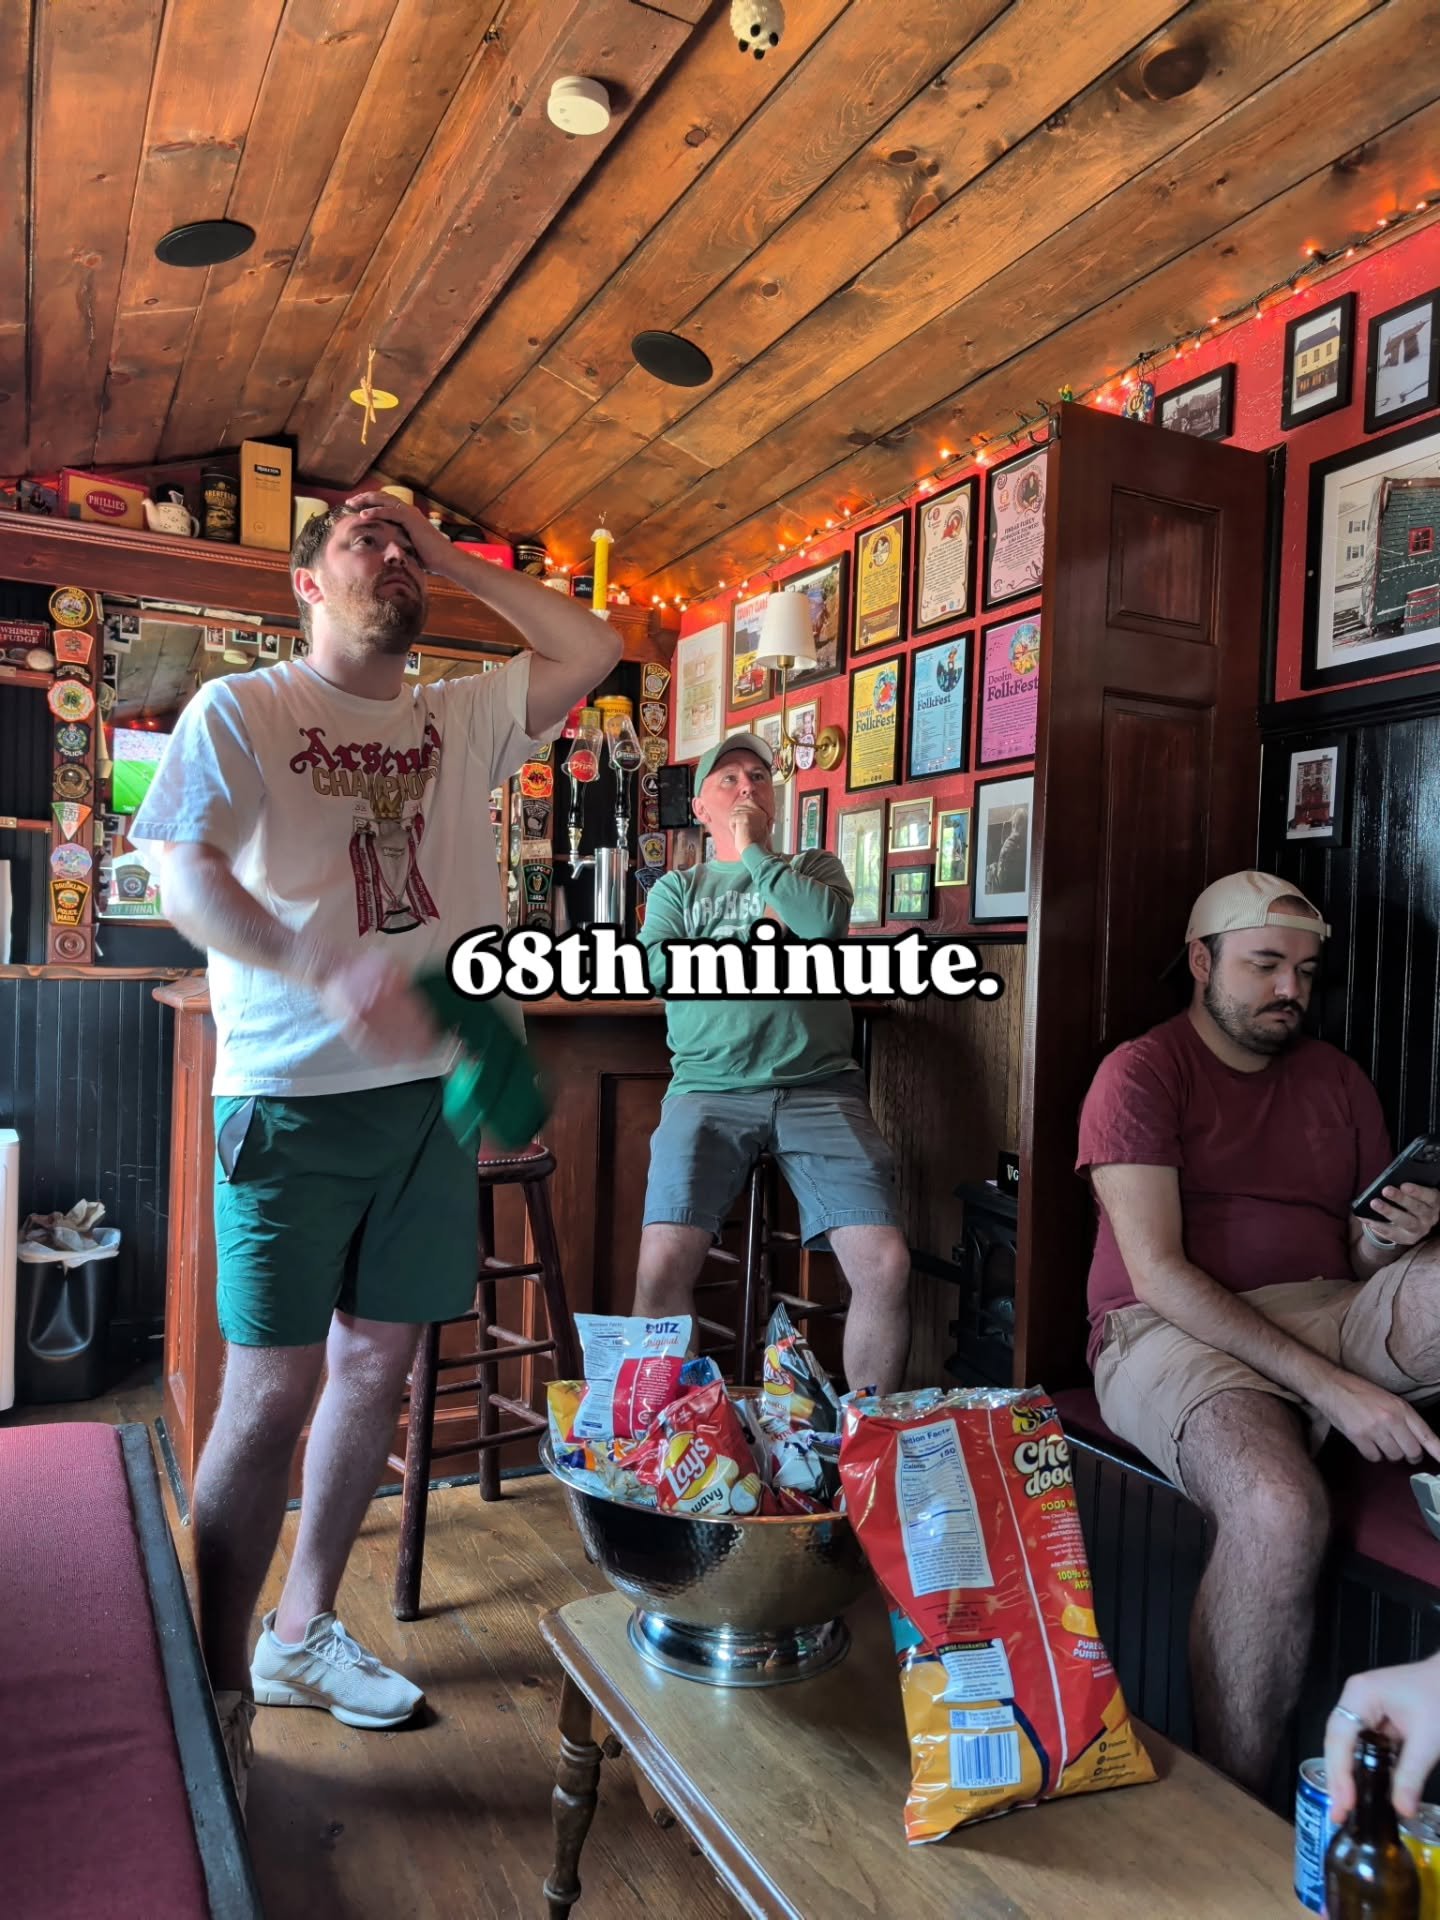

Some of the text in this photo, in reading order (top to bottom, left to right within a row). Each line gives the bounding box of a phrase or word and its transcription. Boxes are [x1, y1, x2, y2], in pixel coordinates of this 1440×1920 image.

[88, 494, 126, 512] PHILLIES
[0, 626, 41, 636] WHISKEY
[3, 634, 39, 644] FUDGE
[987, 670, 1012, 686] Doolin
[987, 676, 1039, 702] FolkFest
[917, 694, 952, 712] FolkFest
[856, 708, 875, 720] Doolin
[856, 713, 896, 734] FolkFest
[290, 712, 442, 776] Arsenal
[59, 748, 84, 758] POLICE
[927, 1428, 951, 1440] Facts
[690, 1487, 724, 1514] wavy
